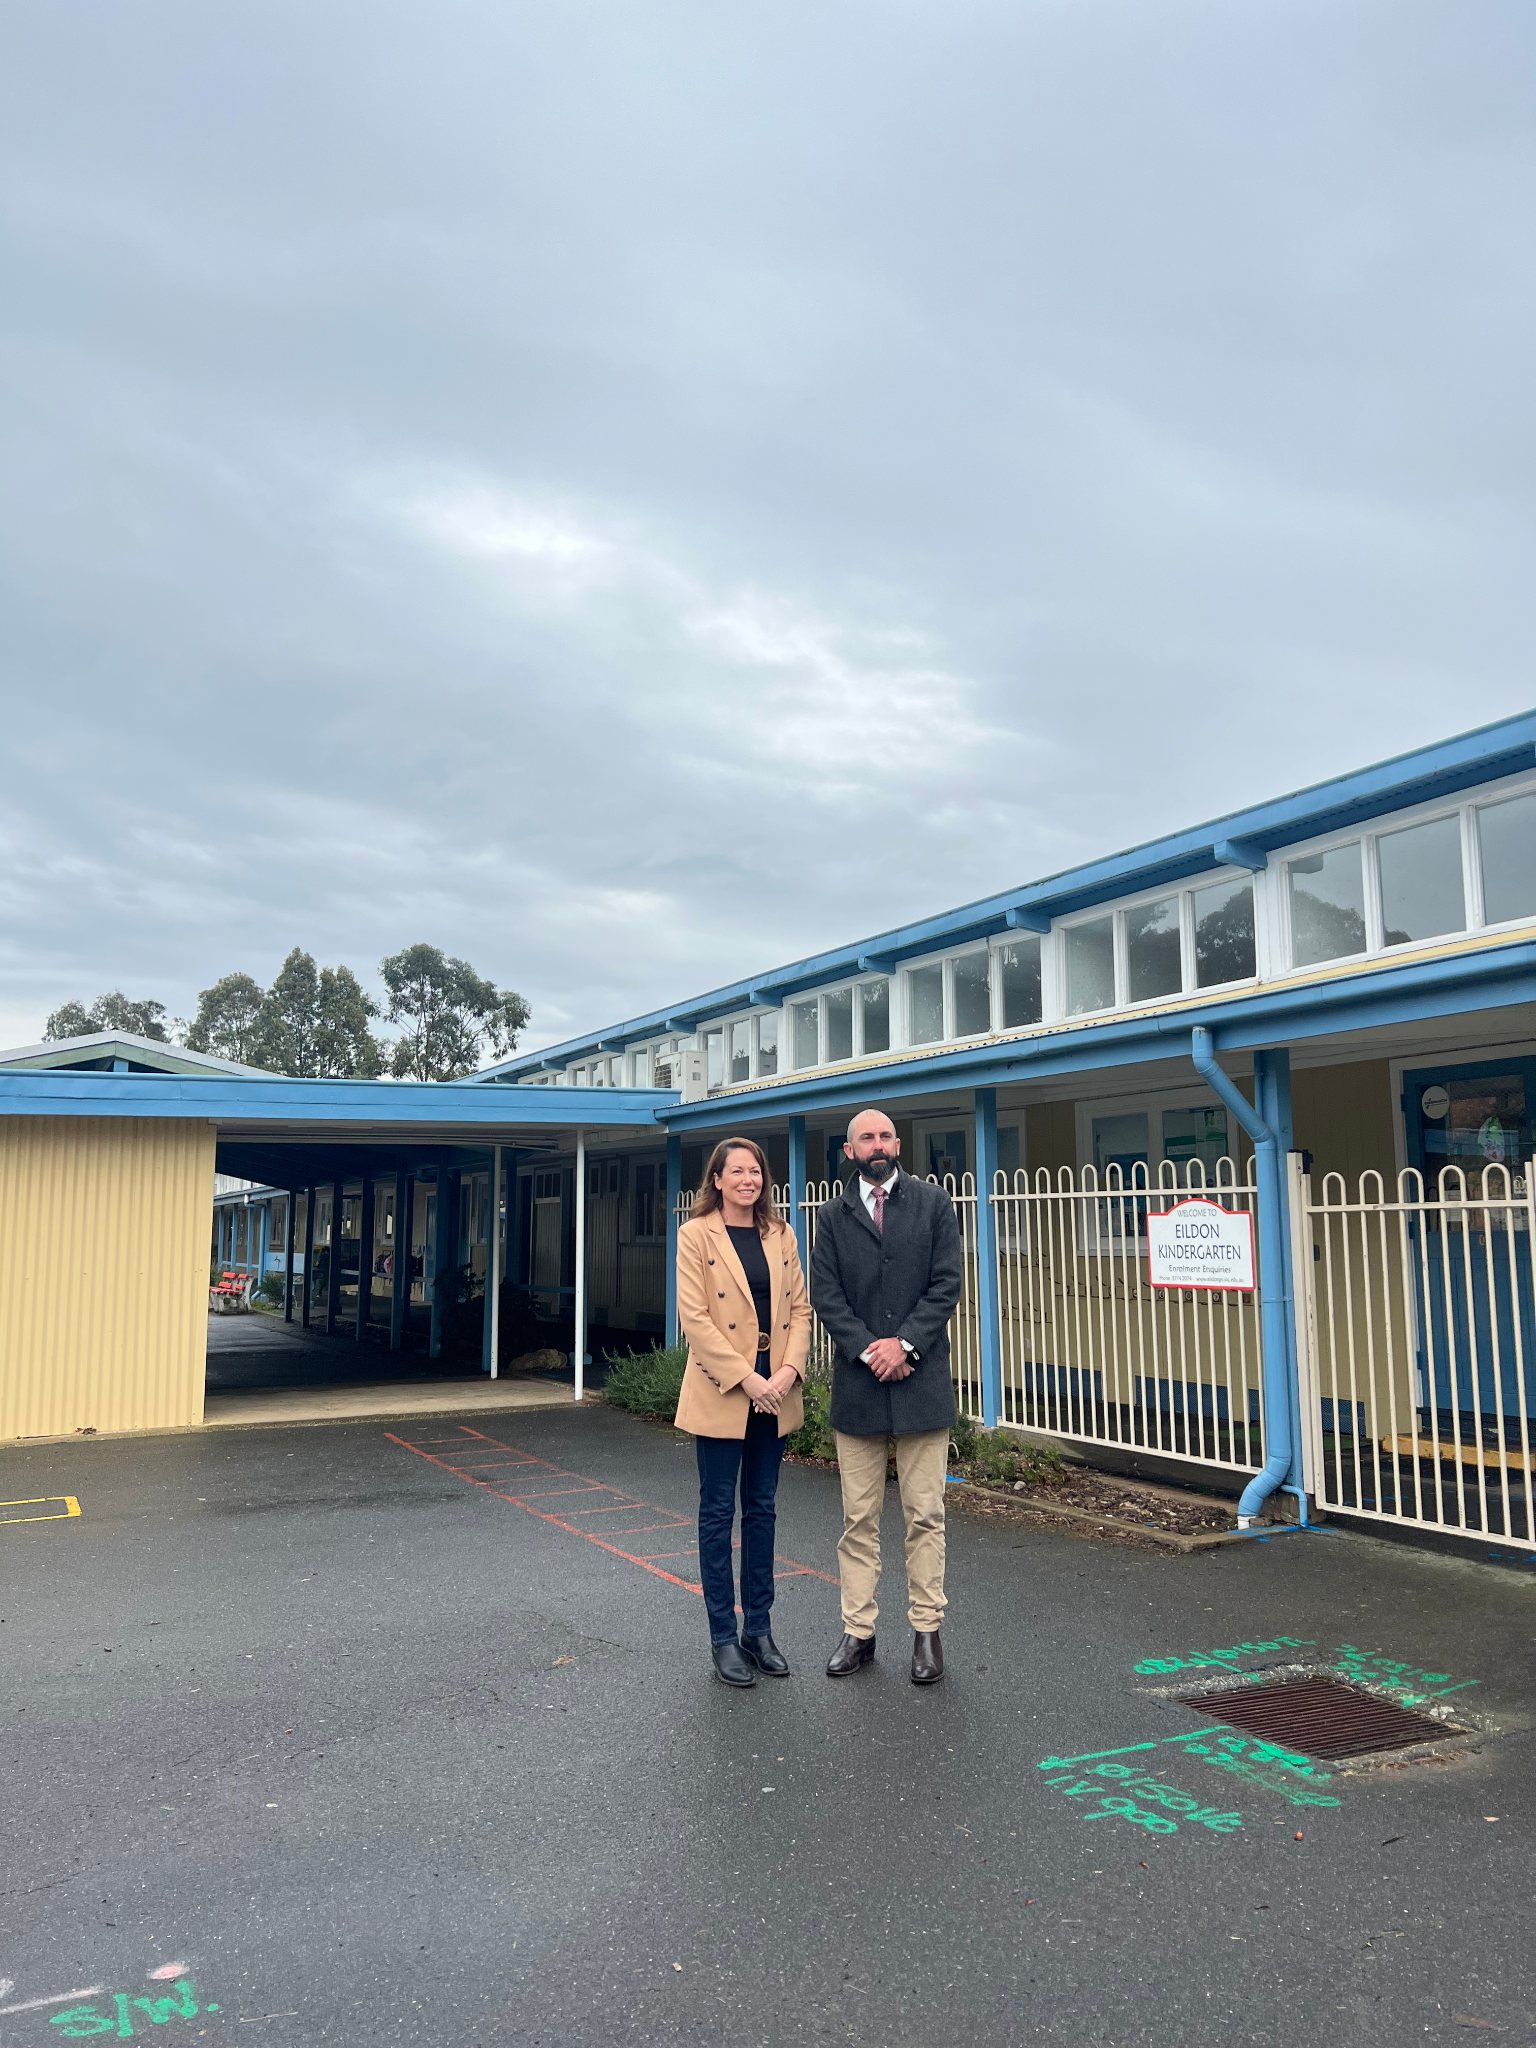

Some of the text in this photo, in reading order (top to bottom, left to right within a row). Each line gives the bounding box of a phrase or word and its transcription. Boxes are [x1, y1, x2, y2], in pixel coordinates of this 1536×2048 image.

[1177, 1208, 1217, 1217] WELCOME TO
[1175, 1224, 1220, 1238] EILDON
[1158, 1244, 1241, 1260] KINDERGARTEN
[1168, 1264, 1232, 1274] Enrolment Enquiries
